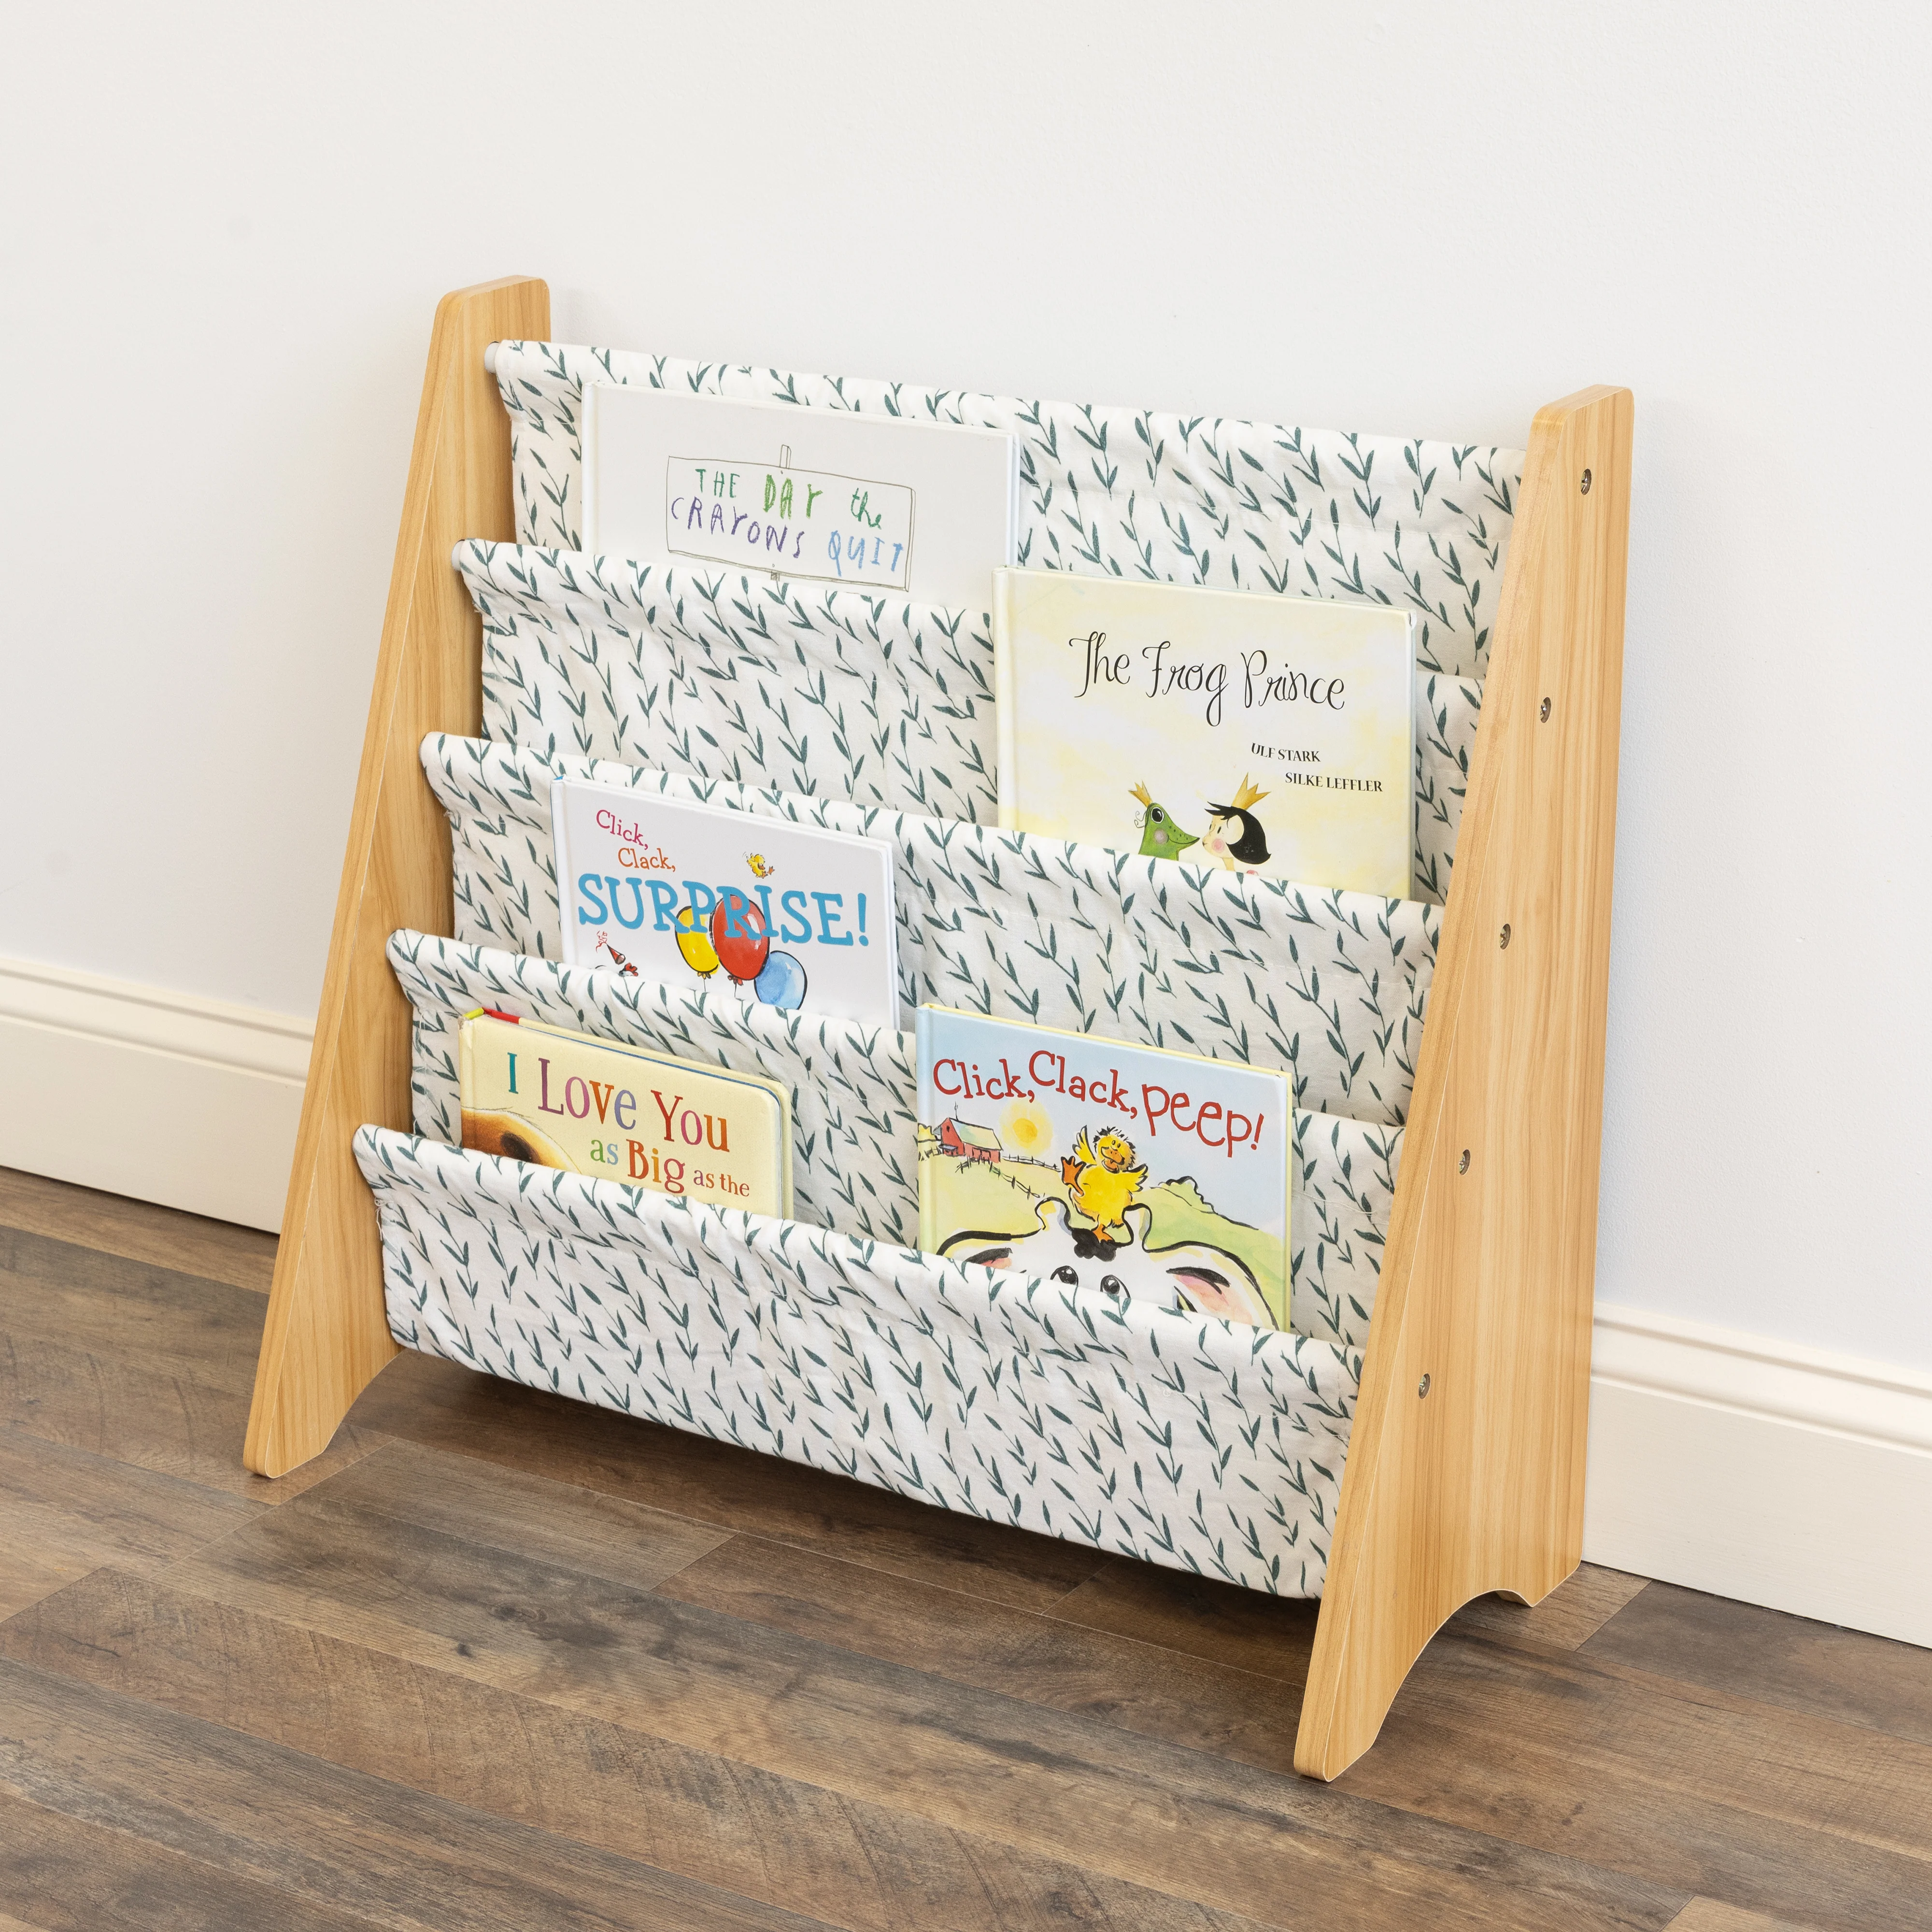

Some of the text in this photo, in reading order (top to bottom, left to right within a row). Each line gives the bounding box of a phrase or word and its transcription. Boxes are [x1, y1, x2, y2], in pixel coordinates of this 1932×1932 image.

[695, 469, 882, 529] THE DAY the
[670, 497, 903, 577] CRAYONS QUIT
[1068, 631, 1345, 726] The Frog Prince
[1251, 742, 1321, 762] ULF STARK
[1285, 772, 1383, 793] SILKE LEFFLER
[596, 810, 648, 850] Click,
[618, 848, 676, 871] Clack,
[578, 873, 869, 947] SURPRISE!
[507, 1052, 729, 1152] I Love You
[933, 1059, 1036, 1103] Click,
[1029, 1050, 1138, 1119] Clack,
[590, 1139, 750, 1197] as Big as the
